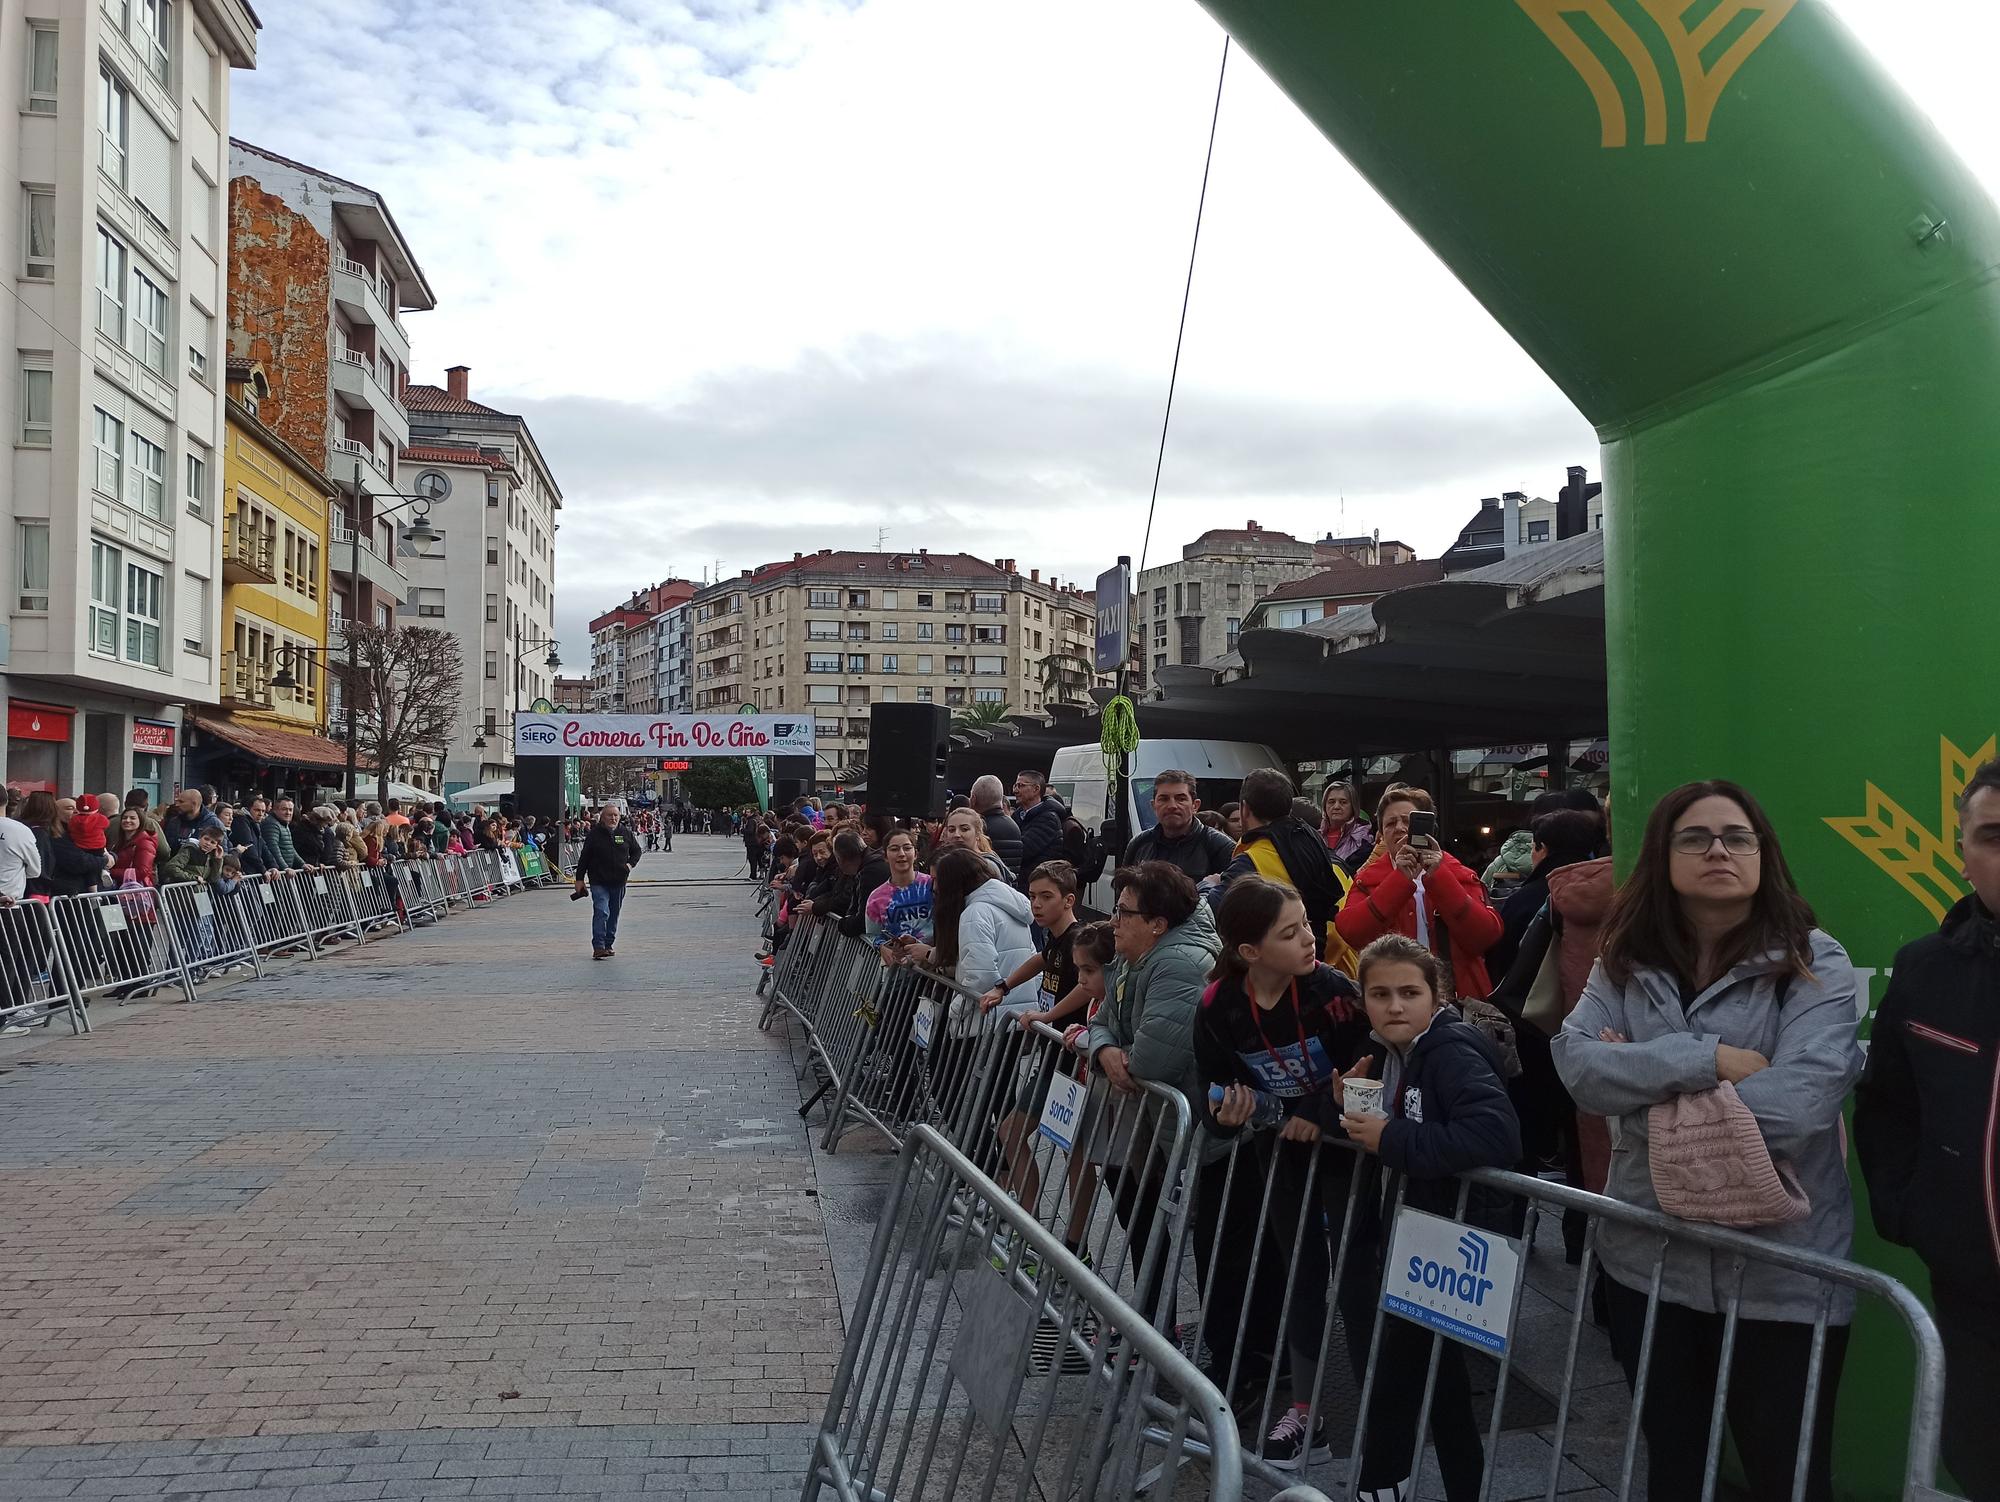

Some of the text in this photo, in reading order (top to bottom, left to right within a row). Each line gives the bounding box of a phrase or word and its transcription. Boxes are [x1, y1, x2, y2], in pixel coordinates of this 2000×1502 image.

[1097, 602, 1120, 638] TAXI
[134, 735, 163, 745] MASCOTAS
[140, 727, 152, 735] CASA
[158, 728, 166, 736] LAS
[562, 721, 770, 749] Carrera Fin De Año
[888, 905, 929, 923] VANS
[1049, 1100, 1074, 1127] sonar
[1407, 1255, 1494, 1307] sonar
[1404, 1290, 1488, 1327] eventos
[1388, 1298, 1501, 1348] 984 08 55 28 www.sonareventos.com
